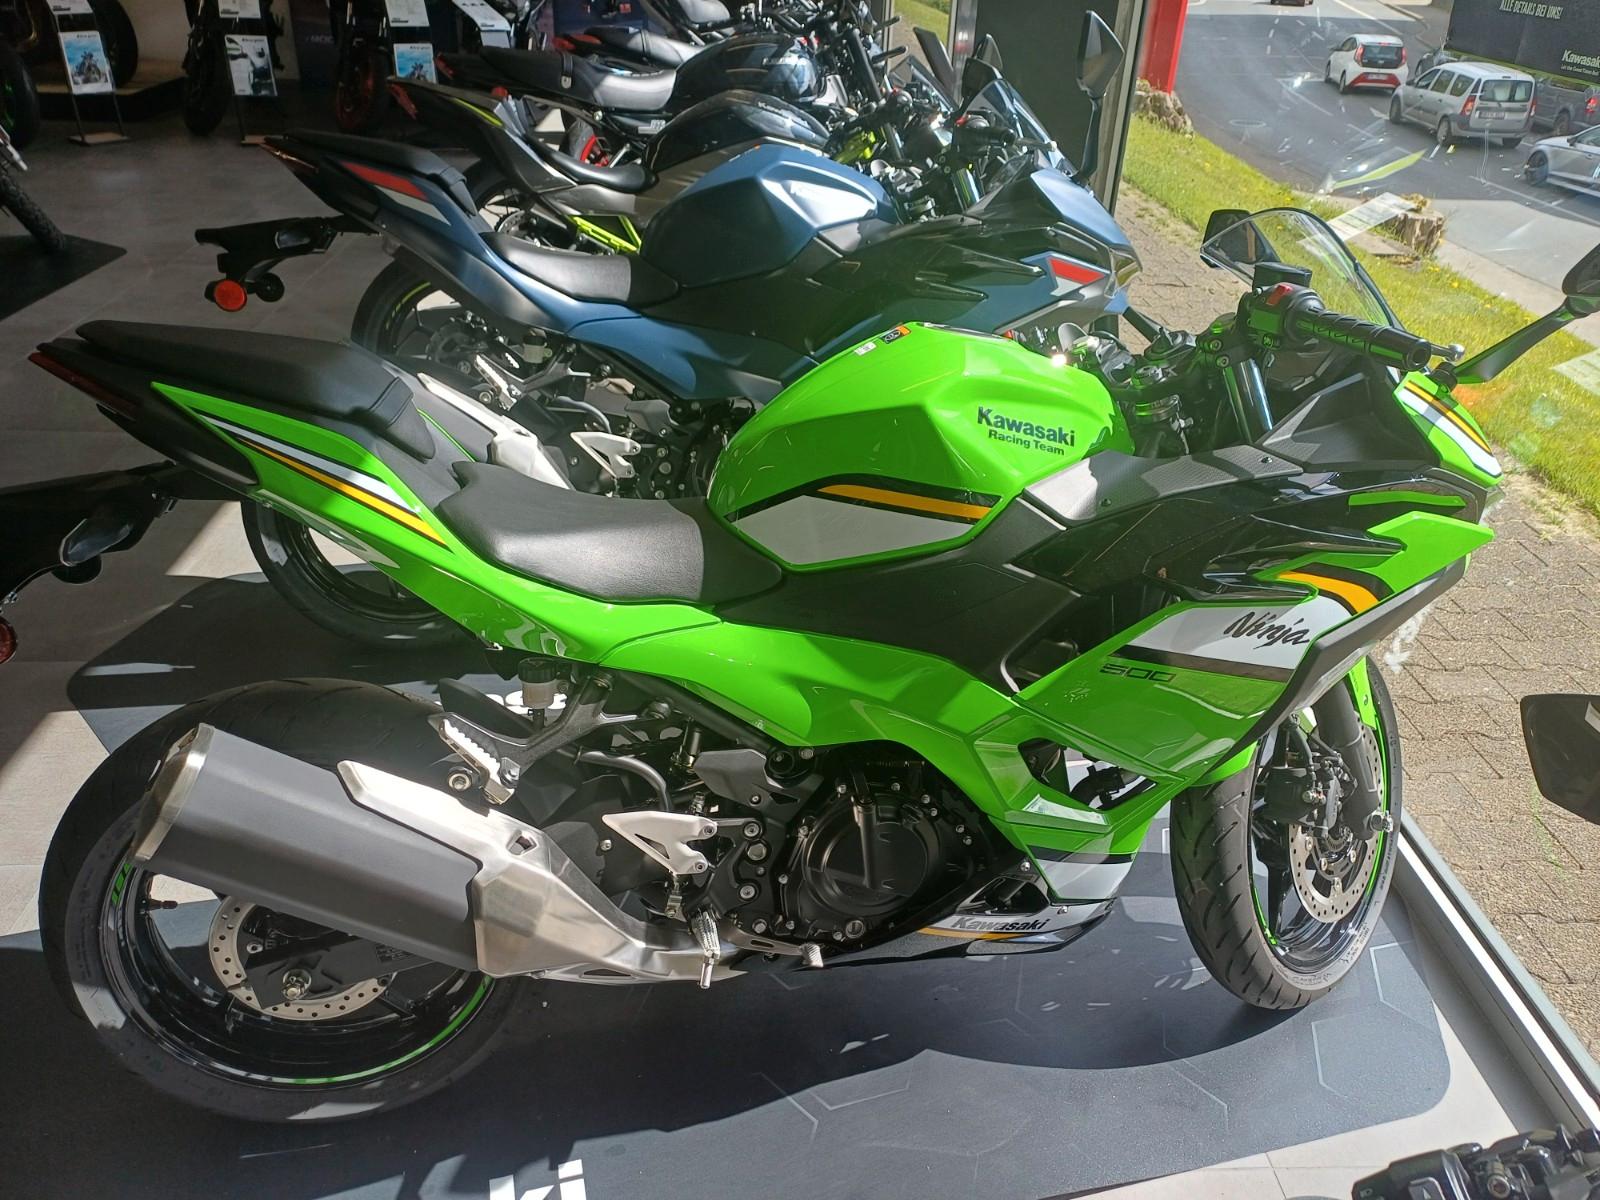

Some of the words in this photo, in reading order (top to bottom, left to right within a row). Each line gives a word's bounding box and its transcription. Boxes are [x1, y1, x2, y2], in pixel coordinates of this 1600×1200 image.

[1499, 0, 1514, 12] ALLE
[1513, 1, 1536, 16] DETAILS
[1535, 4, 1547, 17] BEI
[1547, 5, 1564, 19] UNS!
[977, 406, 1076, 447] Kawasaki
[988, 429, 1031, 449] Racing
[1033, 440, 1065, 456] Team
[1223, 611, 1311, 650] Ninja
[1099, 662, 1176, 683] 500
[951, 916, 1051, 931] Kawasaki
